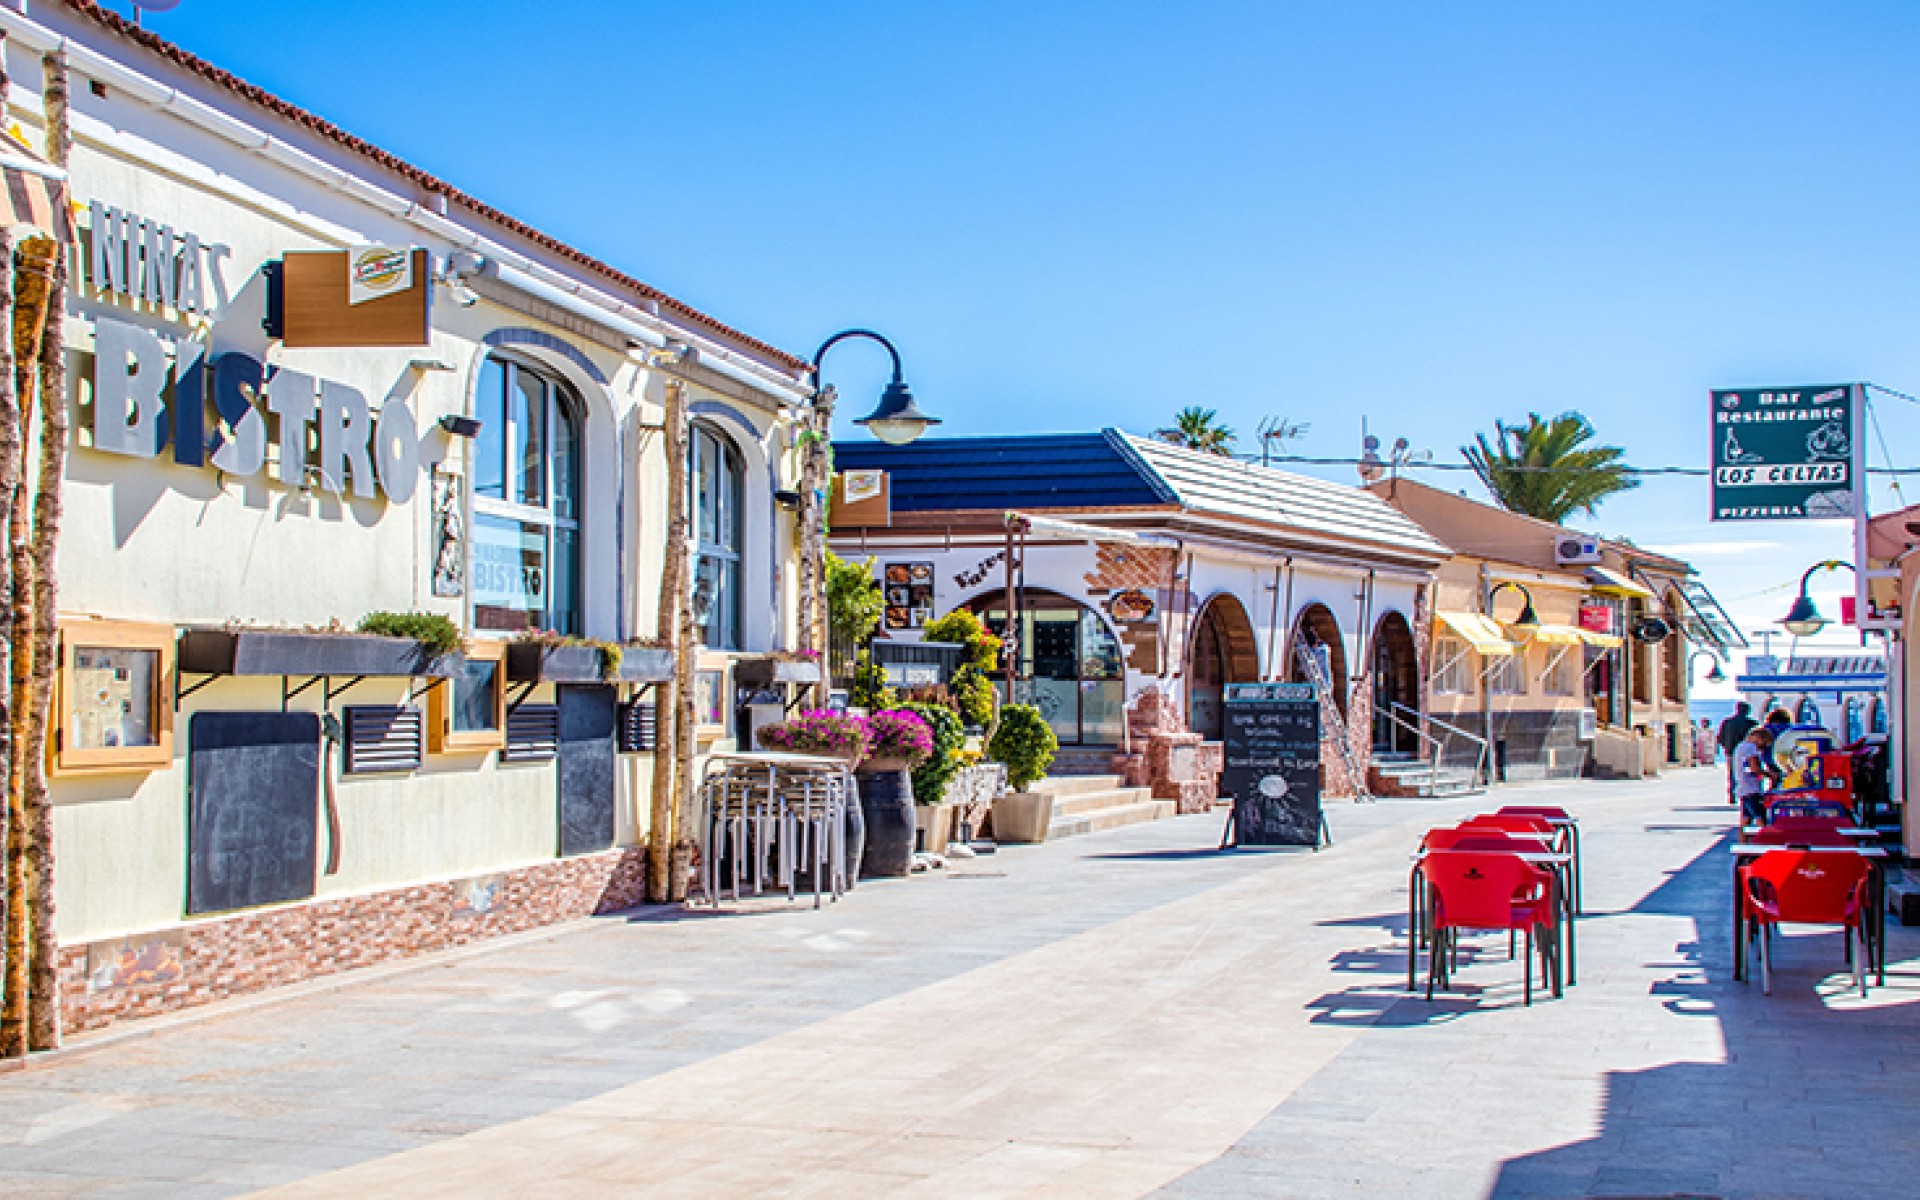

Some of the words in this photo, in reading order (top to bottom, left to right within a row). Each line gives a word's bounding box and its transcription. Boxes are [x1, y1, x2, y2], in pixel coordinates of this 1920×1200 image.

[89, 199, 231, 320] NINAS
[1759, 392, 1801, 405] Bar
[1716, 407, 1845, 424] Restaurante
[1718, 469, 1756, 484] LOS
[1768, 465, 1844, 482] CELTAS
